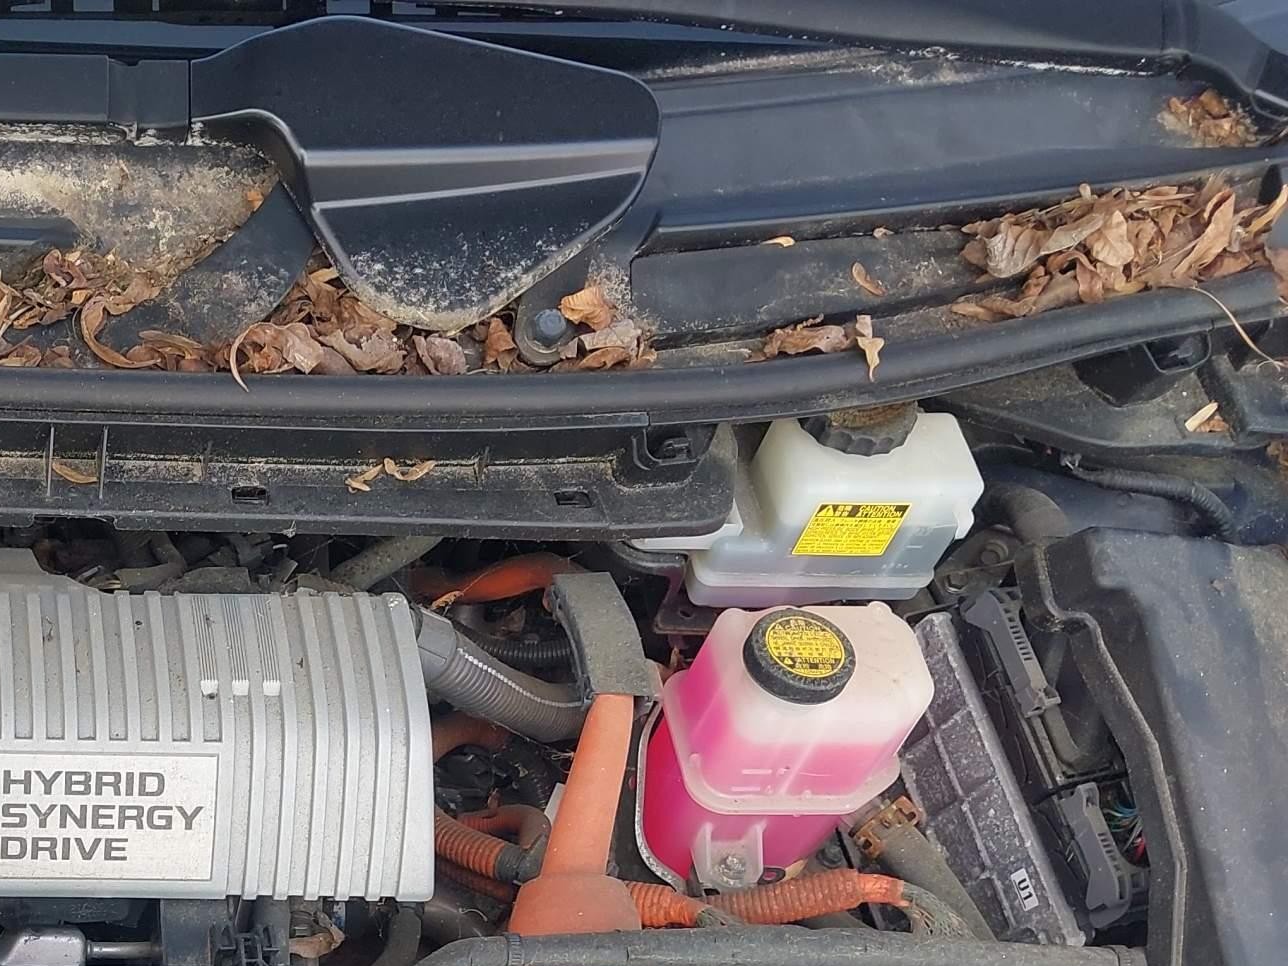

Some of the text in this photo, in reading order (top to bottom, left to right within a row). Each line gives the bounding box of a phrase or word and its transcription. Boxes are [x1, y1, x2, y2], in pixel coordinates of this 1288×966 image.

[2, 770, 165, 797] HYBRID
[0, 803, 204, 830] SYNERGY
[0, 836, 128, 861] DRIVE
[1018, 878, 1032, 900] U1
